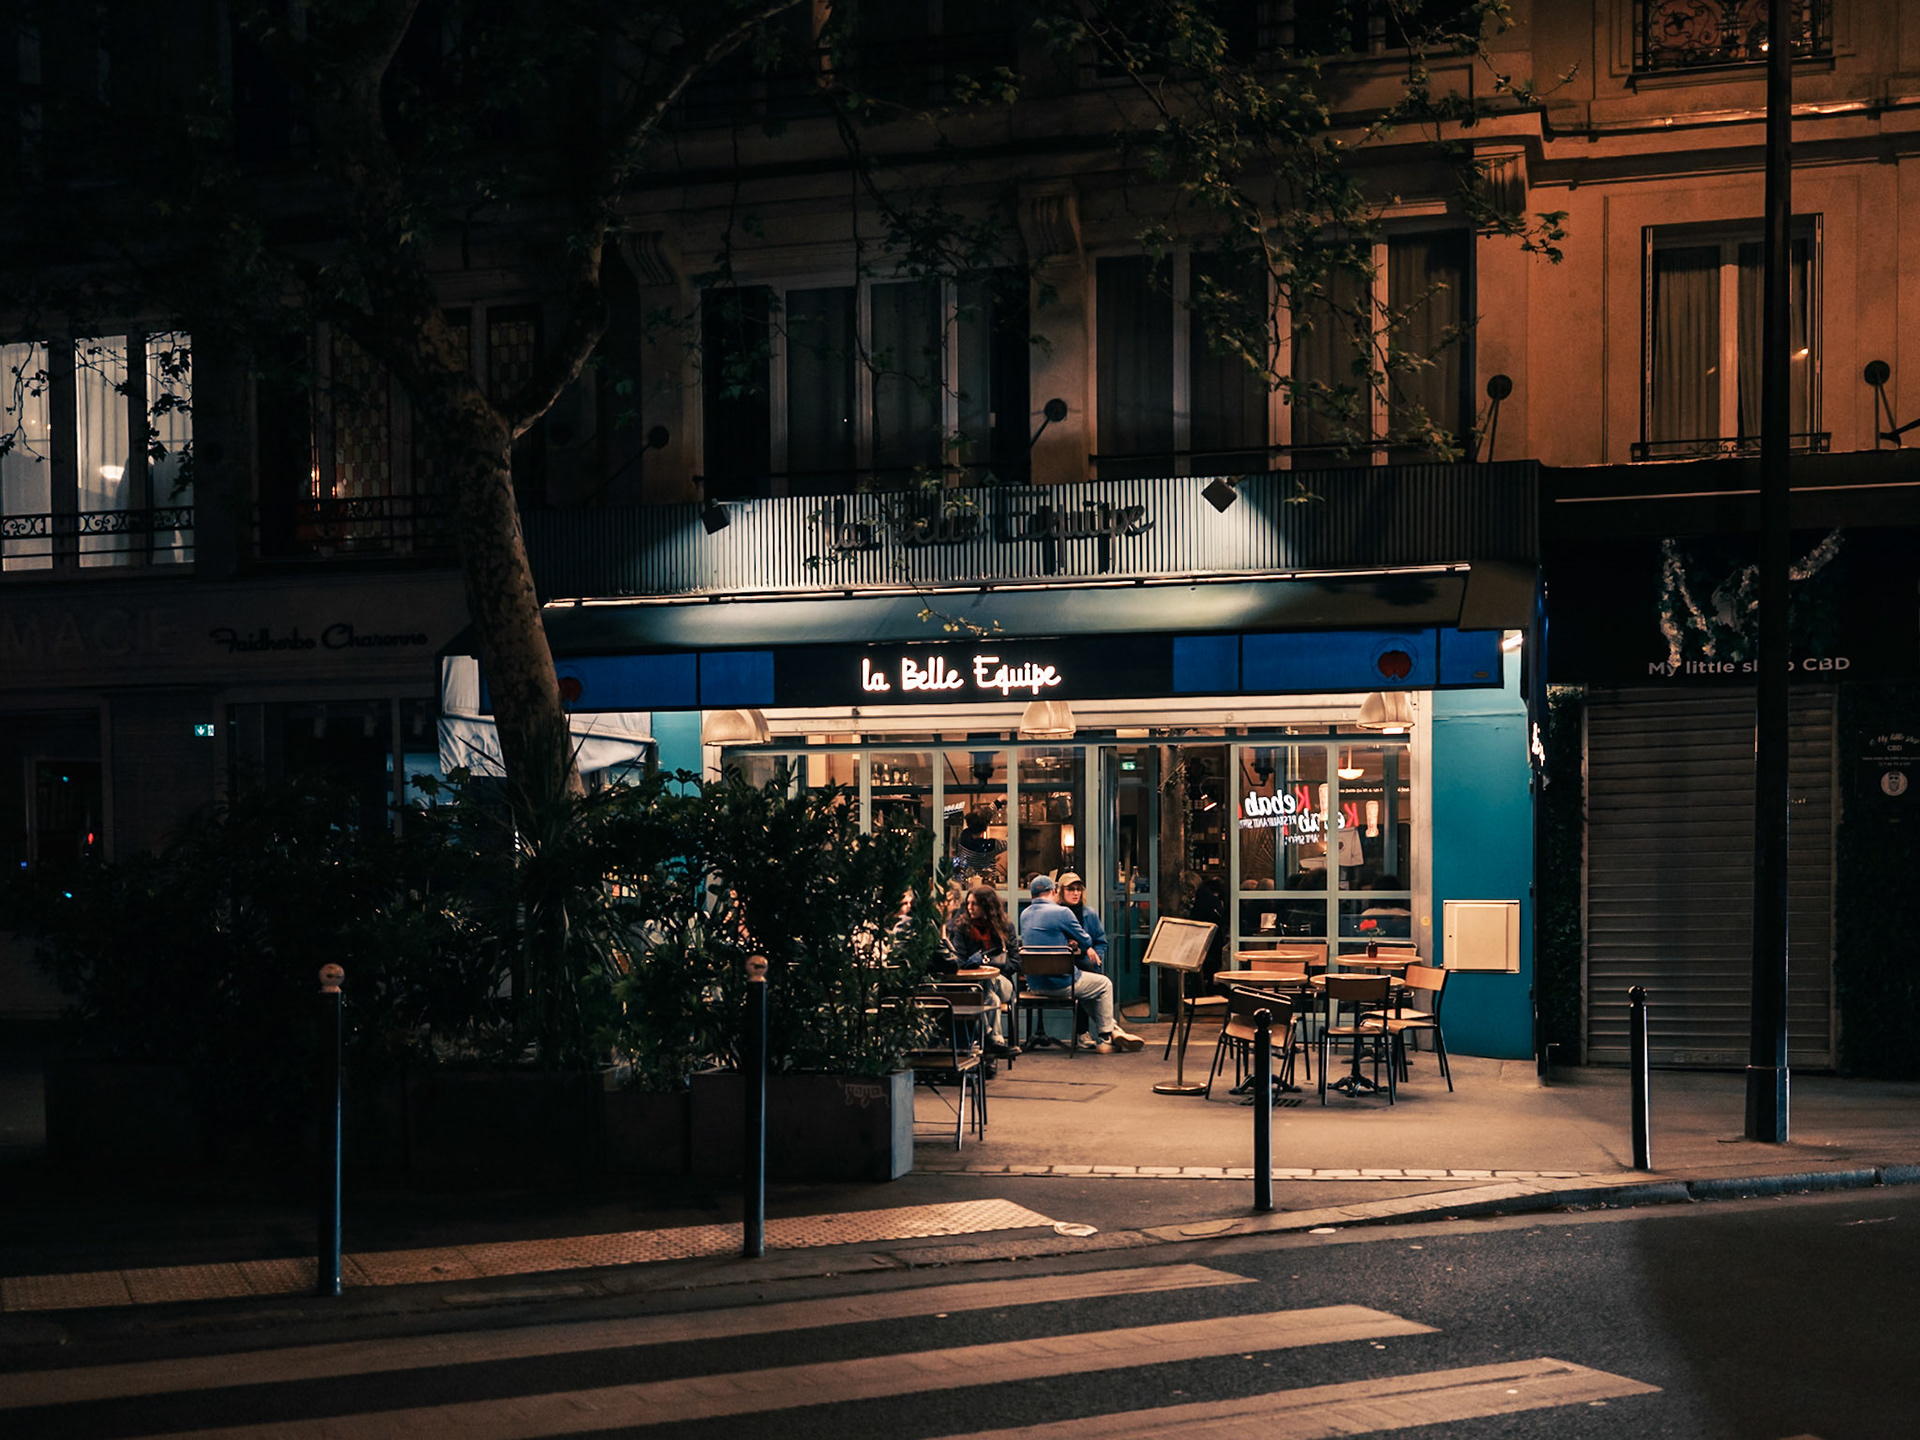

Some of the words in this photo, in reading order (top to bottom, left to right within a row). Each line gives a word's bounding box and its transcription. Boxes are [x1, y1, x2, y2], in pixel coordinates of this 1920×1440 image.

[321, 622, 430, 650] Charonne
[900, 655, 965, 691] Belle
[972, 654, 1062, 697] Equipe
[1648, 661, 1677, 678] My
[1685, 660, 1736, 675] little
[1802, 656, 1851, 671] CBD
